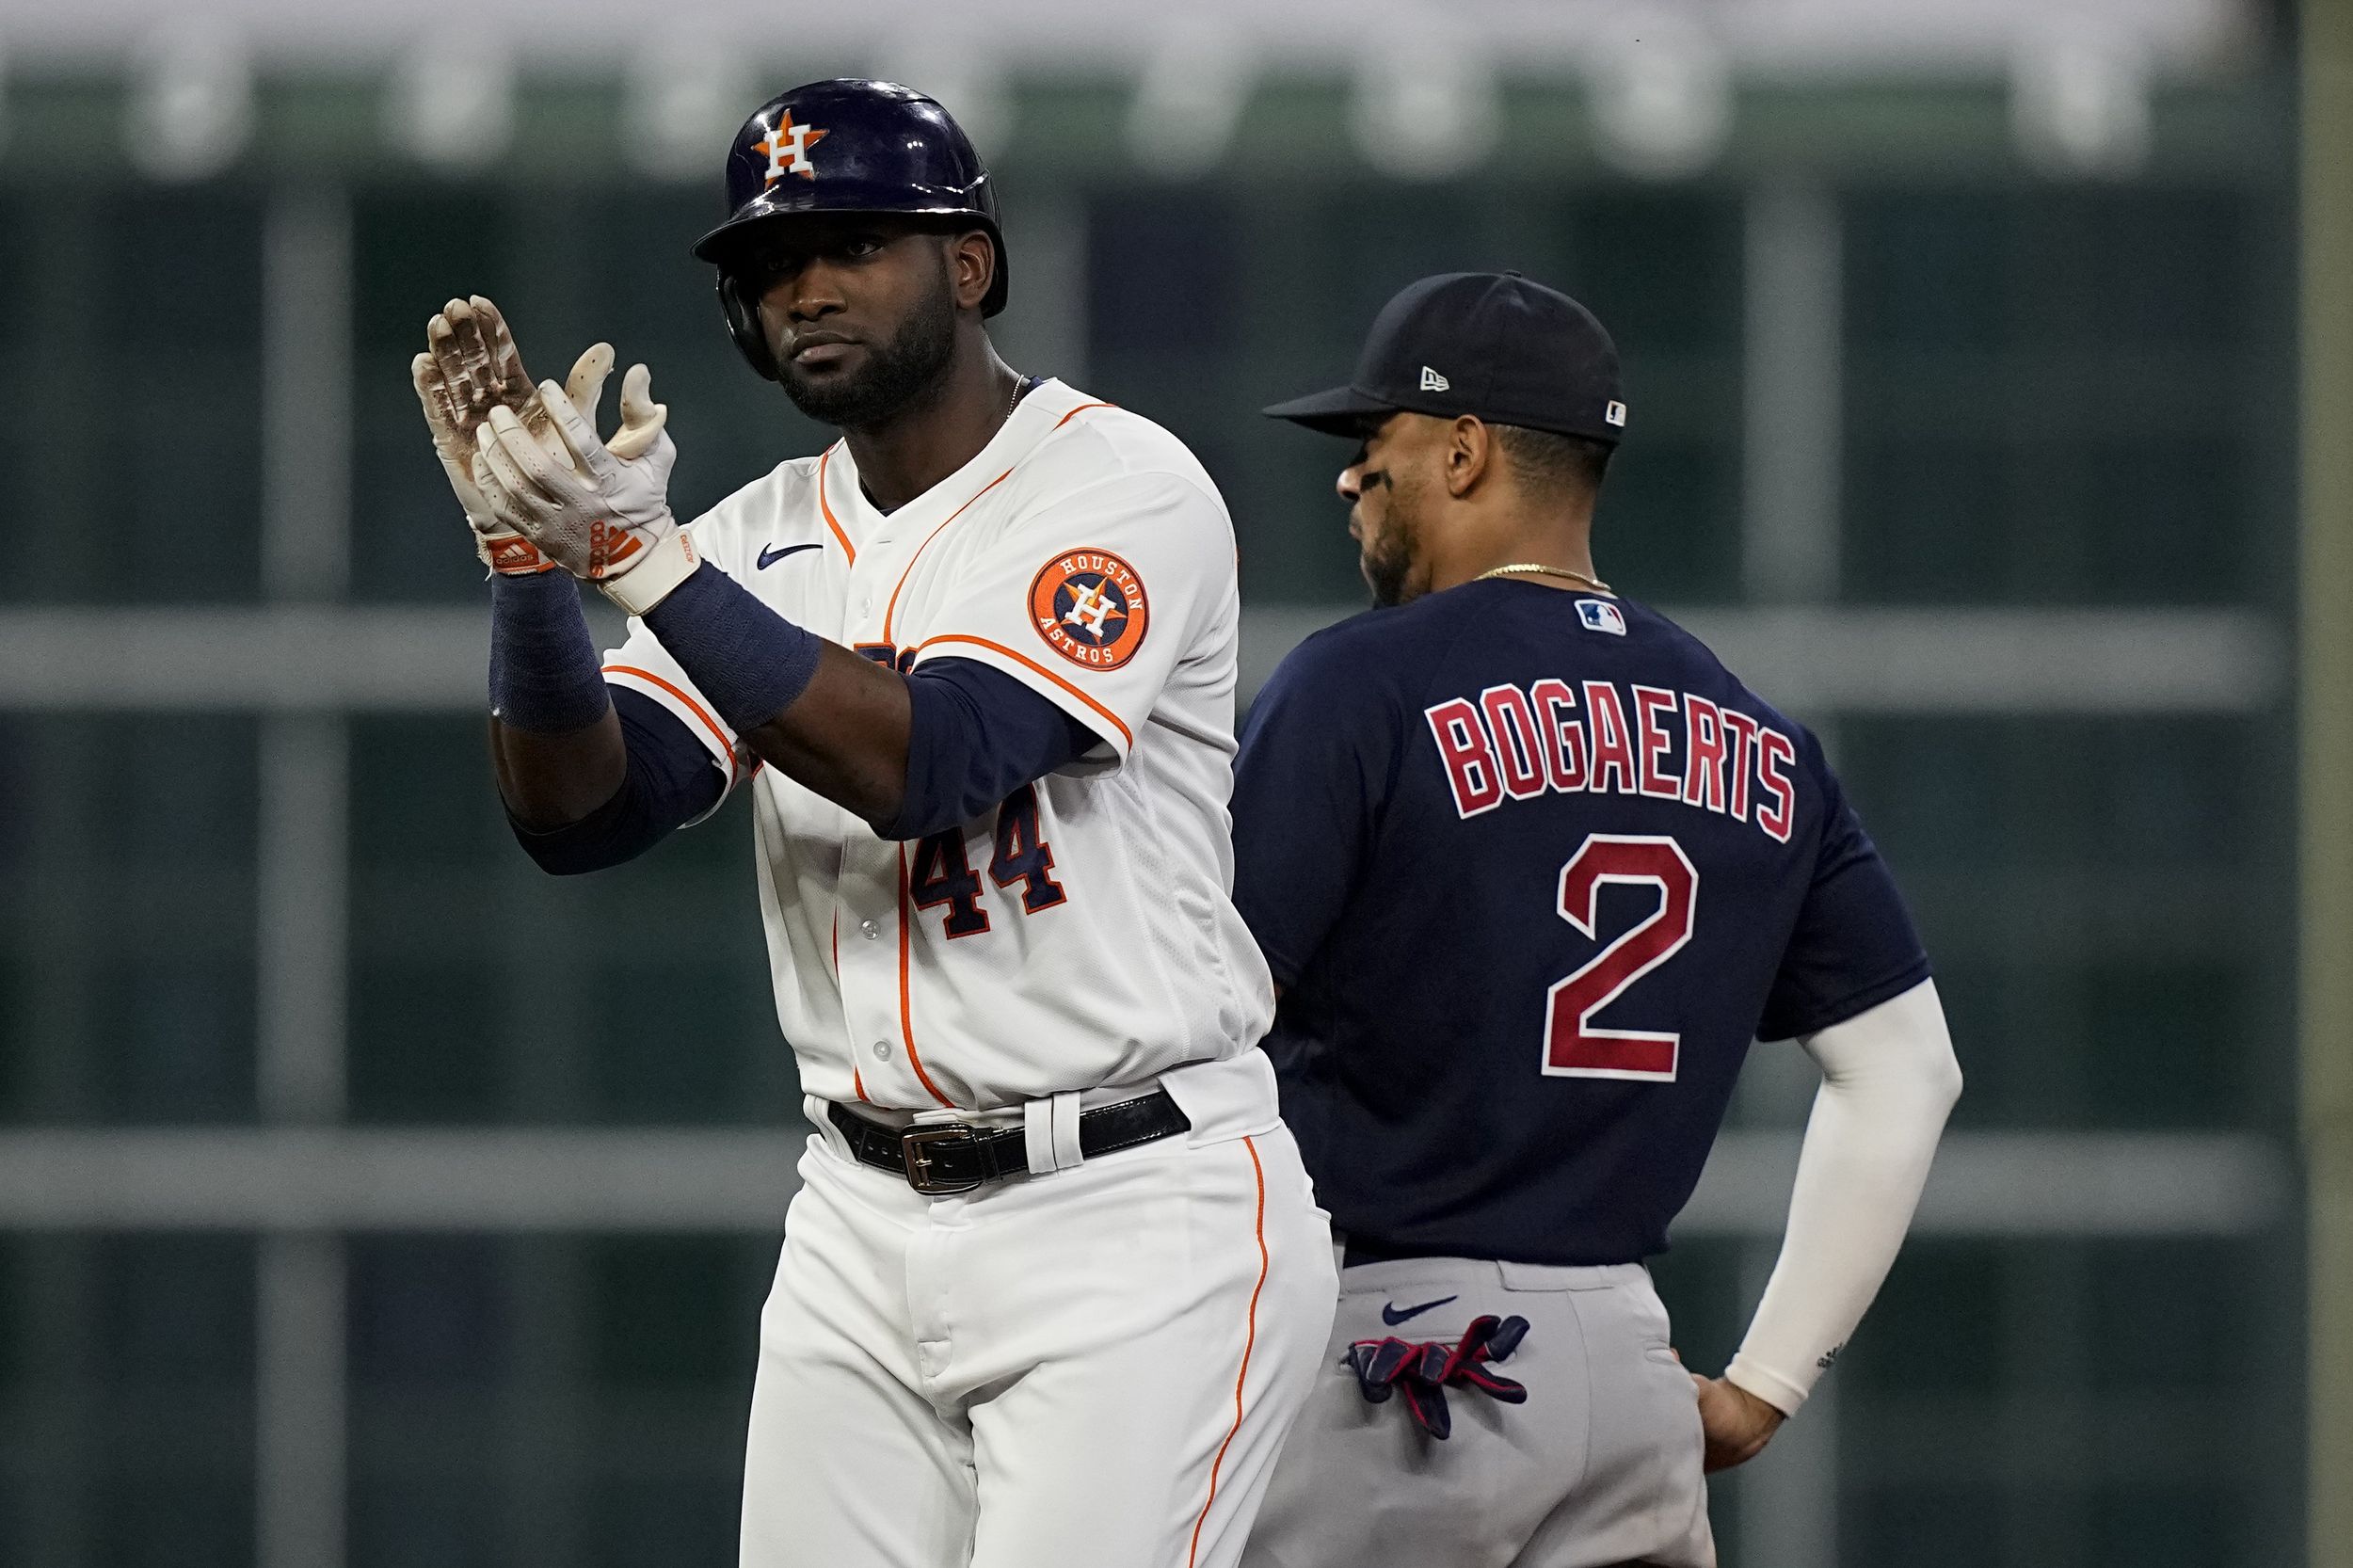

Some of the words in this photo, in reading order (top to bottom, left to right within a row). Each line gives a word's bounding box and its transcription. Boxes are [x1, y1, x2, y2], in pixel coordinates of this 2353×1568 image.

[763, 123, 813, 180] H
[496, 553, 534, 565] adidas
[1060, 555, 1144, 610] HOUSTON
[1064, 583, 1117, 638] H
[1040, 616, 1113, 664] ASTROS
[1424, 678, 1796, 844] BOGAERTS
[909, 781, 1067, 940] 44
[1542, 833, 1699, 1082] 2
